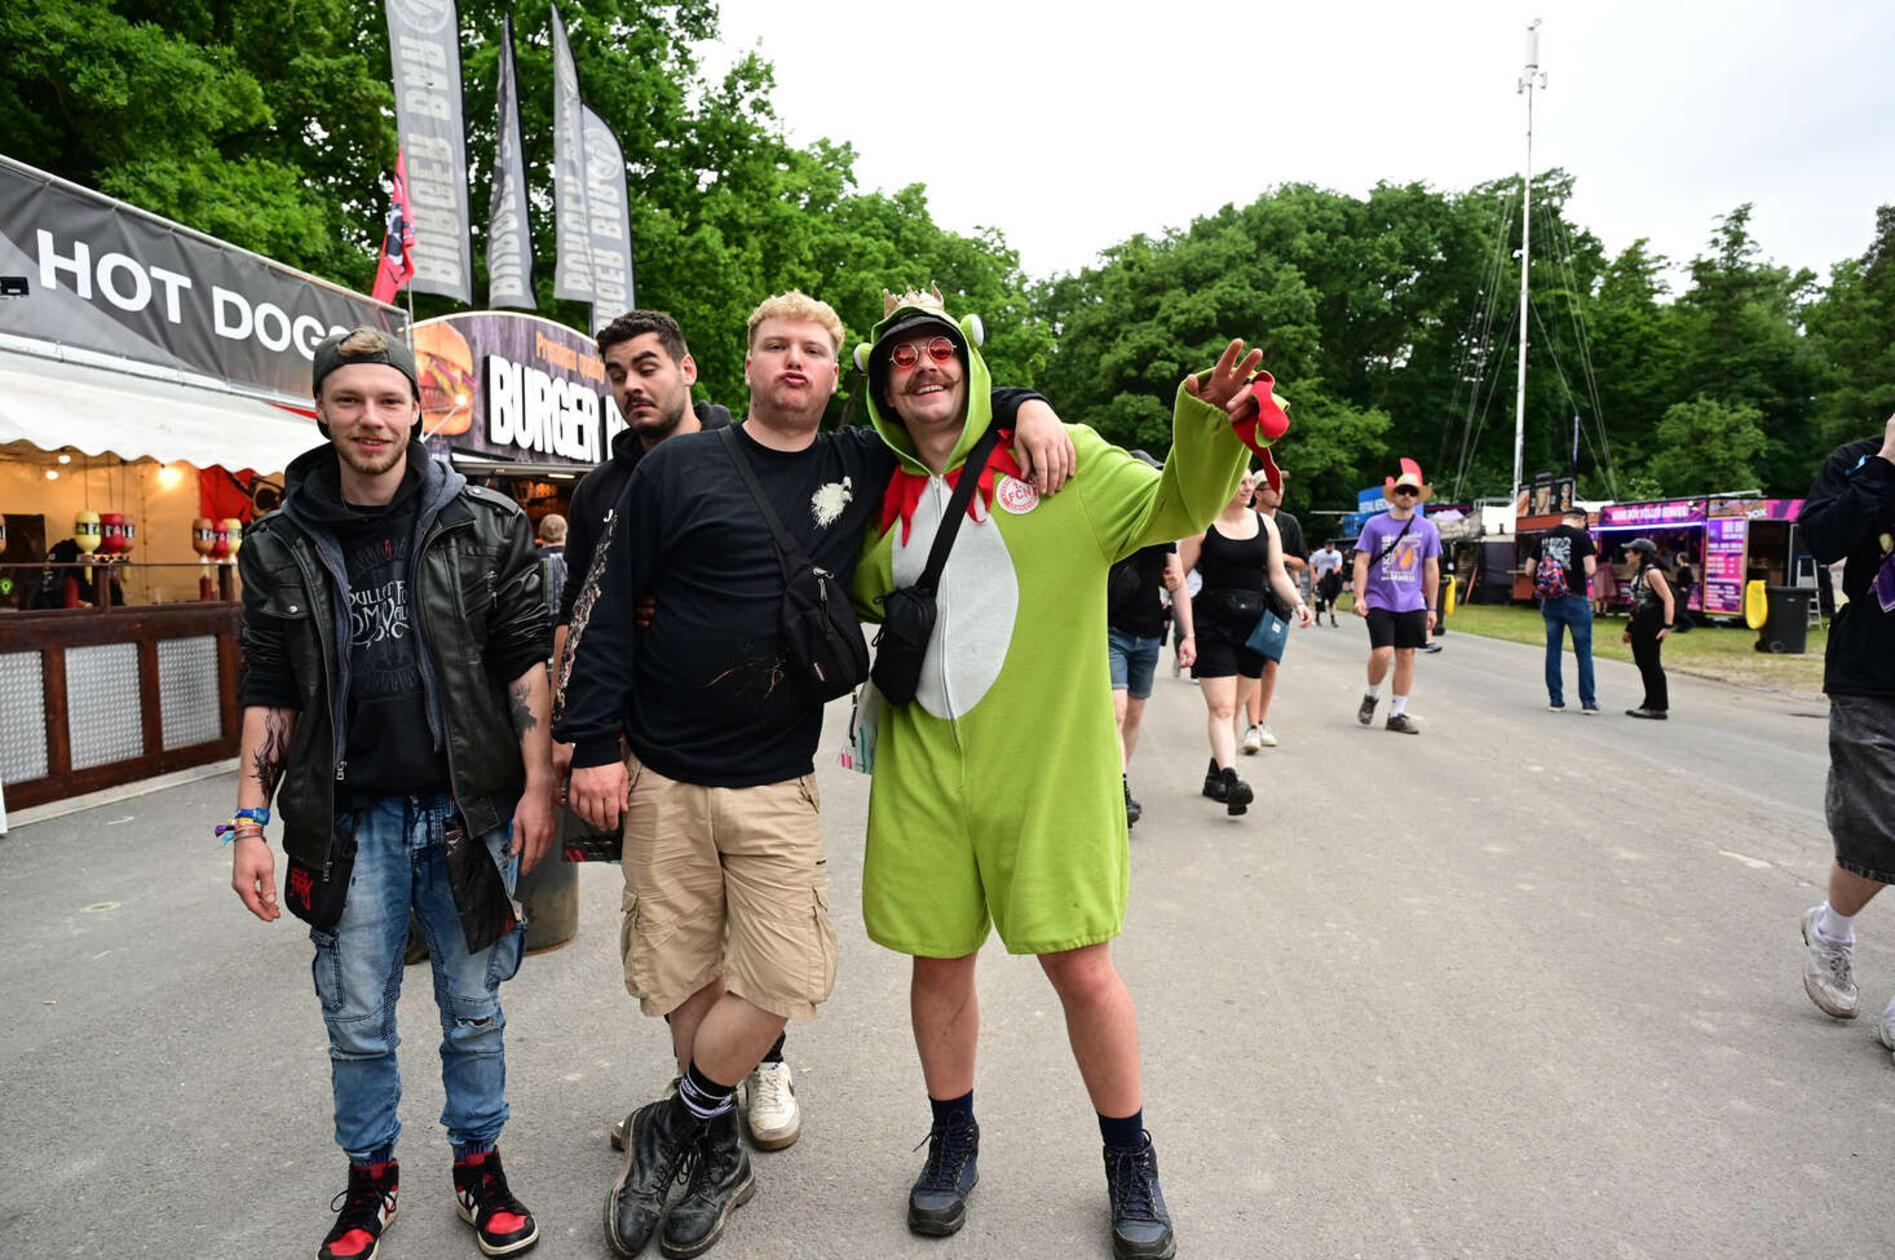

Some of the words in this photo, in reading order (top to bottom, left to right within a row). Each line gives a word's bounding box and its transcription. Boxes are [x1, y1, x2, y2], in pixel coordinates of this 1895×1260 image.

[37, 228, 192, 324] HOT
[212, 286, 350, 362] DOG
[488, 353, 601, 464] BURGER
